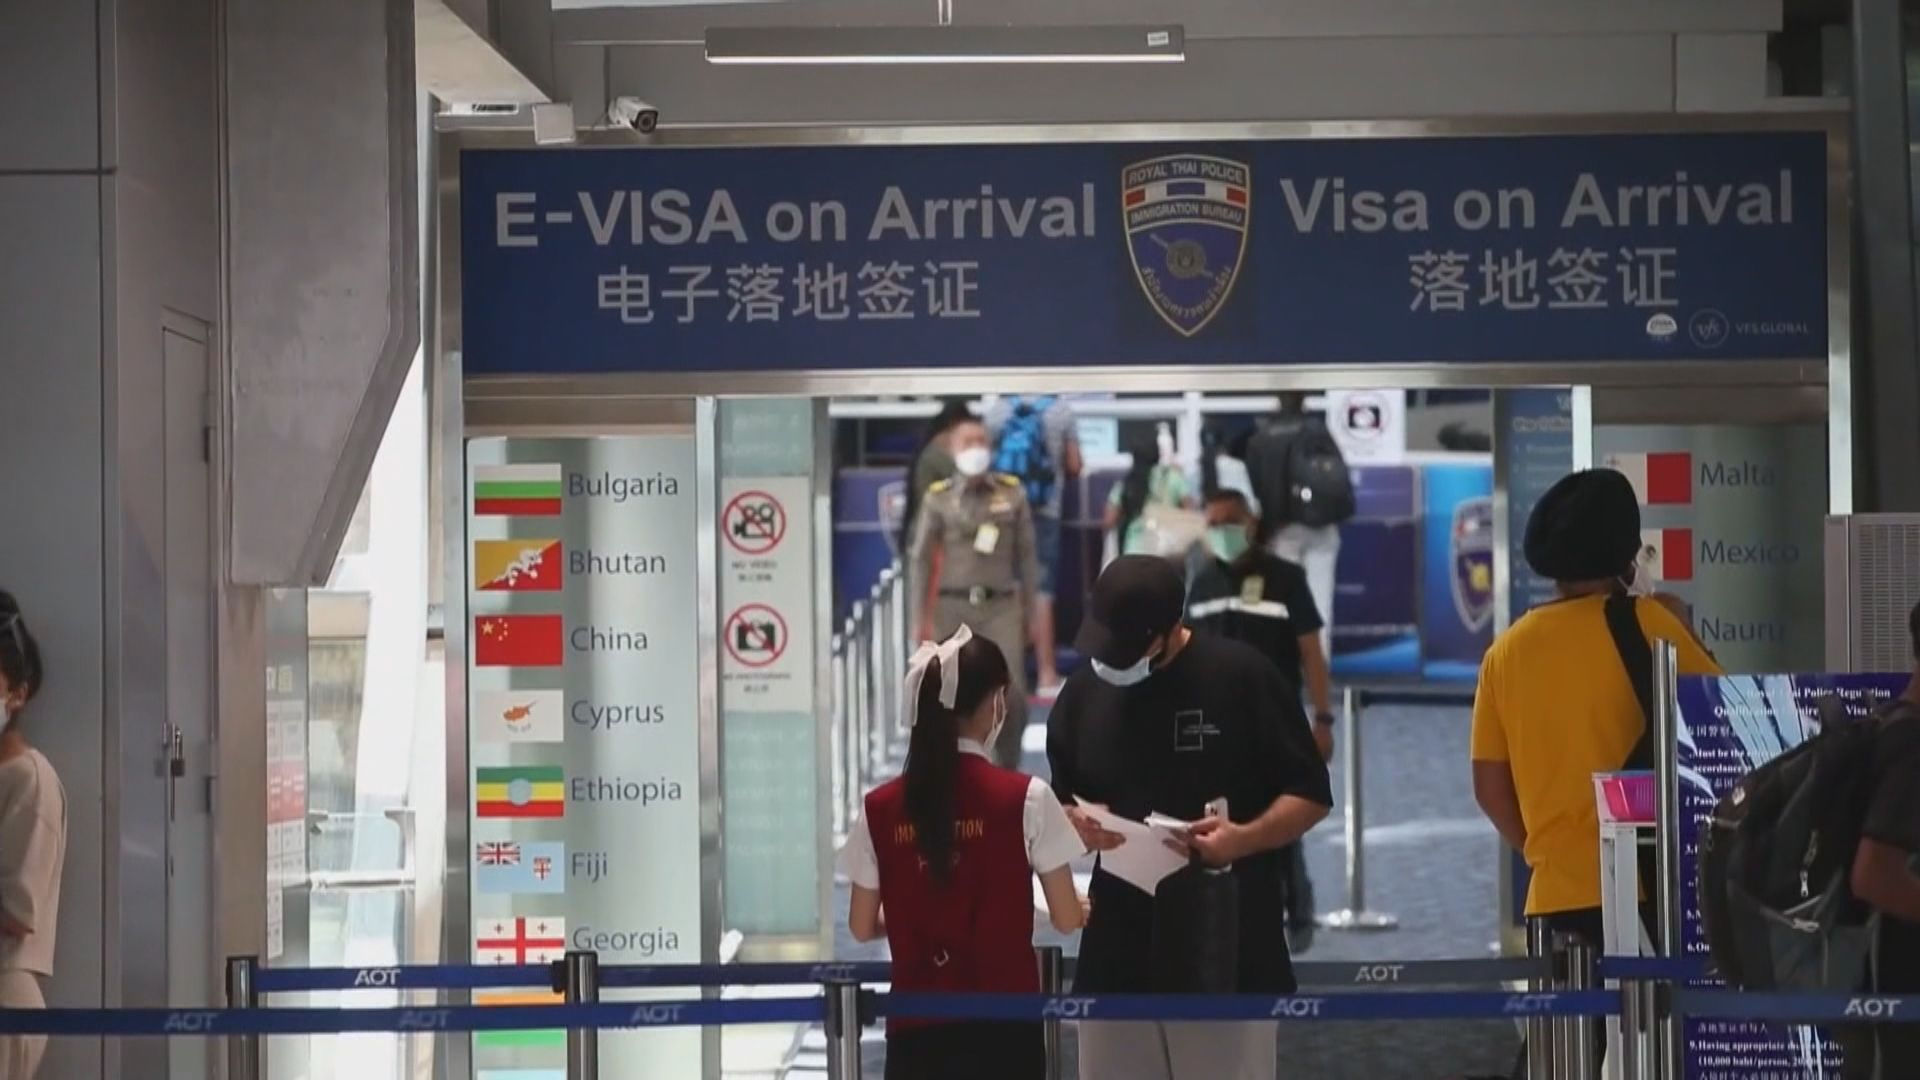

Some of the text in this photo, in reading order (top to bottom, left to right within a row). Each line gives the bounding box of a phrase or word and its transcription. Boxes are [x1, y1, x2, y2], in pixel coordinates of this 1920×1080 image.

[1129, 162, 1243, 184] ROYAL THAI POLICE
[1131, 202, 1242, 224] IMMIGRATION BUREAU
[1279, 168, 1794, 233] Visa on Arrival
[496, 182, 1096, 248] E-VISA on Arrival
[597, 259, 982, 325] 电子落地签证
[1409, 246, 1680, 312] 落地签证
[568, 472, 679, 503] Bulgaria
[1700, 461, 1776, 488] Malta
[569, 549, 667, 577] Bhutan
[1700, 538, 1801, 565] Mexico
[570, 624, 649, 653] China
[1700, 617, 1786, 642] Nauru
[571, 698, 665, 730] Cyprus
[571, 776, 682, 807] Ethiopia
[572, 851, 609, 883] Fiji
[572, 925, 680, 957] Georgia
[354, 968, 401, 986] AOT
[1355, 964, 1404, 982] AOT
[630, 1003, 686, 1023] AOT
[1041, 997, 1097, 1017] AOT
[1271, 998, 1325, 1017] AOT
[1844, 998, 1901, 1017] AOT
[164, 1012, 218, 1031] AOT
